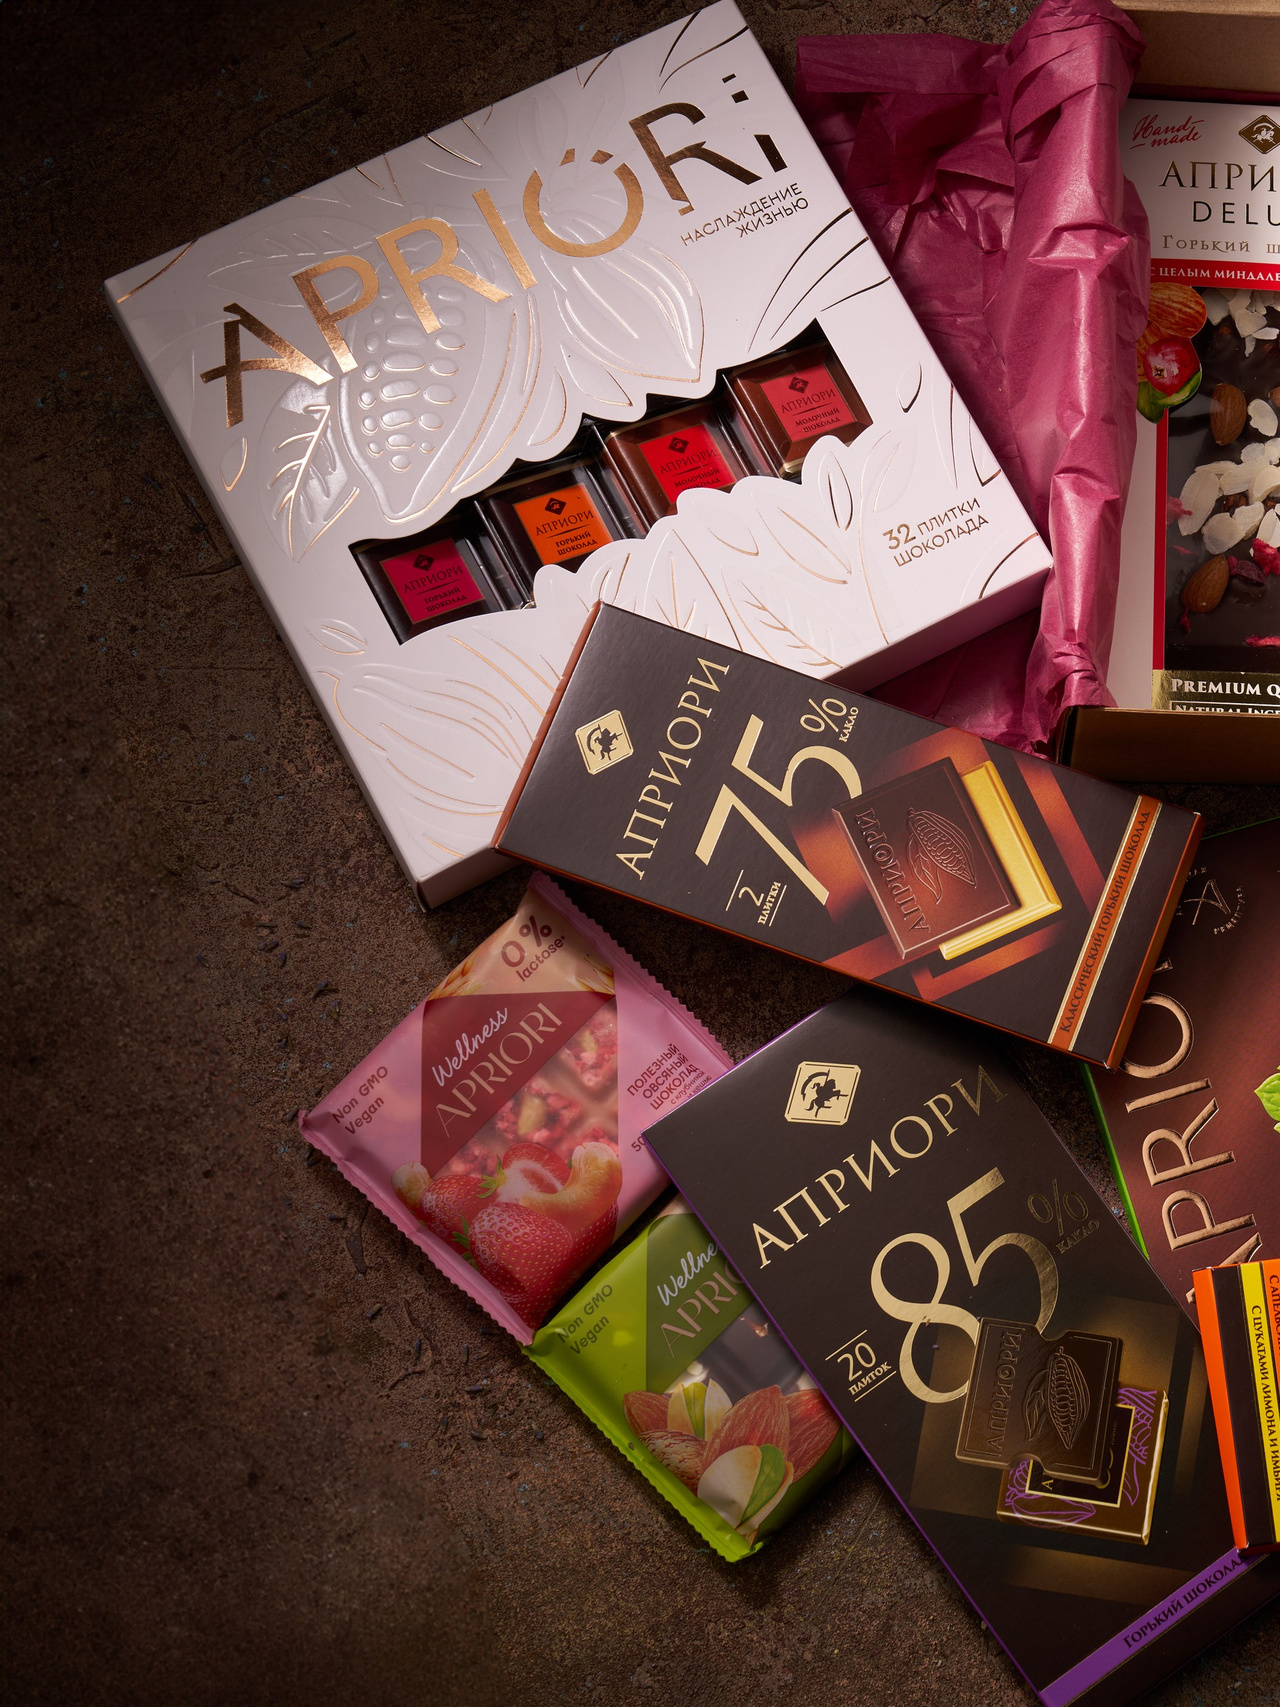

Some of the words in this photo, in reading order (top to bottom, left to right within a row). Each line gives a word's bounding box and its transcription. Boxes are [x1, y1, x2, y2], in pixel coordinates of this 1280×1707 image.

[680, 182, 803, 246] НАСЛАЖДЕНИЕ
[735, 197, 809, 238] ЖИЗНЬЮ
[1159, 267, 1211, 278] ЦЕЛЫМ
[780, 388, 837, 414] АПРИОРИ
[795, 407, 841, 427] МОЛОЧНЫЙ
[802, 416, 841, 433] ШОКОЛАД
[659, 449, 717, 475] АПРИОРИ
[674, 467, 721, 488] МОЛОЧНЫЙ
[534, 509, 595, 537] АПРИОРИ
[555, 531, 591, 548] ГОРЬКИЙ
[882, 523, 916, 549] 32
[917, 497, 981, 535] ПЛИТКИ
[893, 514, 989, 567] ШОКОЛАДА
[557, 539, 598, 557] ШОКОЛАД
[403, 565, 464, 594] АПРИОРИ
[423, 587, 461, 604] ГОРЬКИЙ
[426, 595, 468, 613] ШОКОЛАД
[1172, 678, 1262, 696] PREMIUM
[838, 706, 860, 743] КАКАО
[615, 657, 730, 881] АПРИОРИ
[855, 807, 931, 933] АПРИОРИ
[738, 886, 765, 906] 2
[757, 881, 782, 925] ПЛИТКИ
[1059, 930, 1104, 1033] КЛАССИЧЕСКИЙ
[1097, 875, 1126, 932] ГОРЬКИЙ
[1122, 811, 1151, 877] ШОКОЛАД
[431, 1007, 508, 1087] Wellness
[436, 1002, 563, 1138] APRIORI
[626, 1042, 681, 1097] ПОЛЕЗНЫЙ
[642, 1053, 689, 1099] ОВСЯНЫЙ
[649, 1064, 701, 1111] ШОКОЛАД
[332, 1097, 359, 1124] Non
[358, 1066, 388, 1097] GMO
[344, 1095, 385, 1135] Vegan
[752, 1064, 1008, 1269] АПРИОРИ
[1055, 1219, 1100, 1254] КАКАО
[1269, 1274, 1280, 1285] С
[557, 1316, 584, 1343] Non
[583, 1284, 614, 1316] GMO
[1251, 1305, 1262, 1315] С
[569, 1315, 610, 1355] Vegan
[1252, 1316, 1269, 1381] ЦУКАТАМИ
[837, 1341, 877, 1382] 20
[848, 1360, 892, 1397] ПЛИТОК
[985, 1331, 1023, 1453] АПРИОРИ
[1262, 1382, 1276, 1437] ЛИМОНА
[1269, 1437, 1278, 1448] И
[1122, 1598, 1185, 1649] ГОРЬКИЙ
